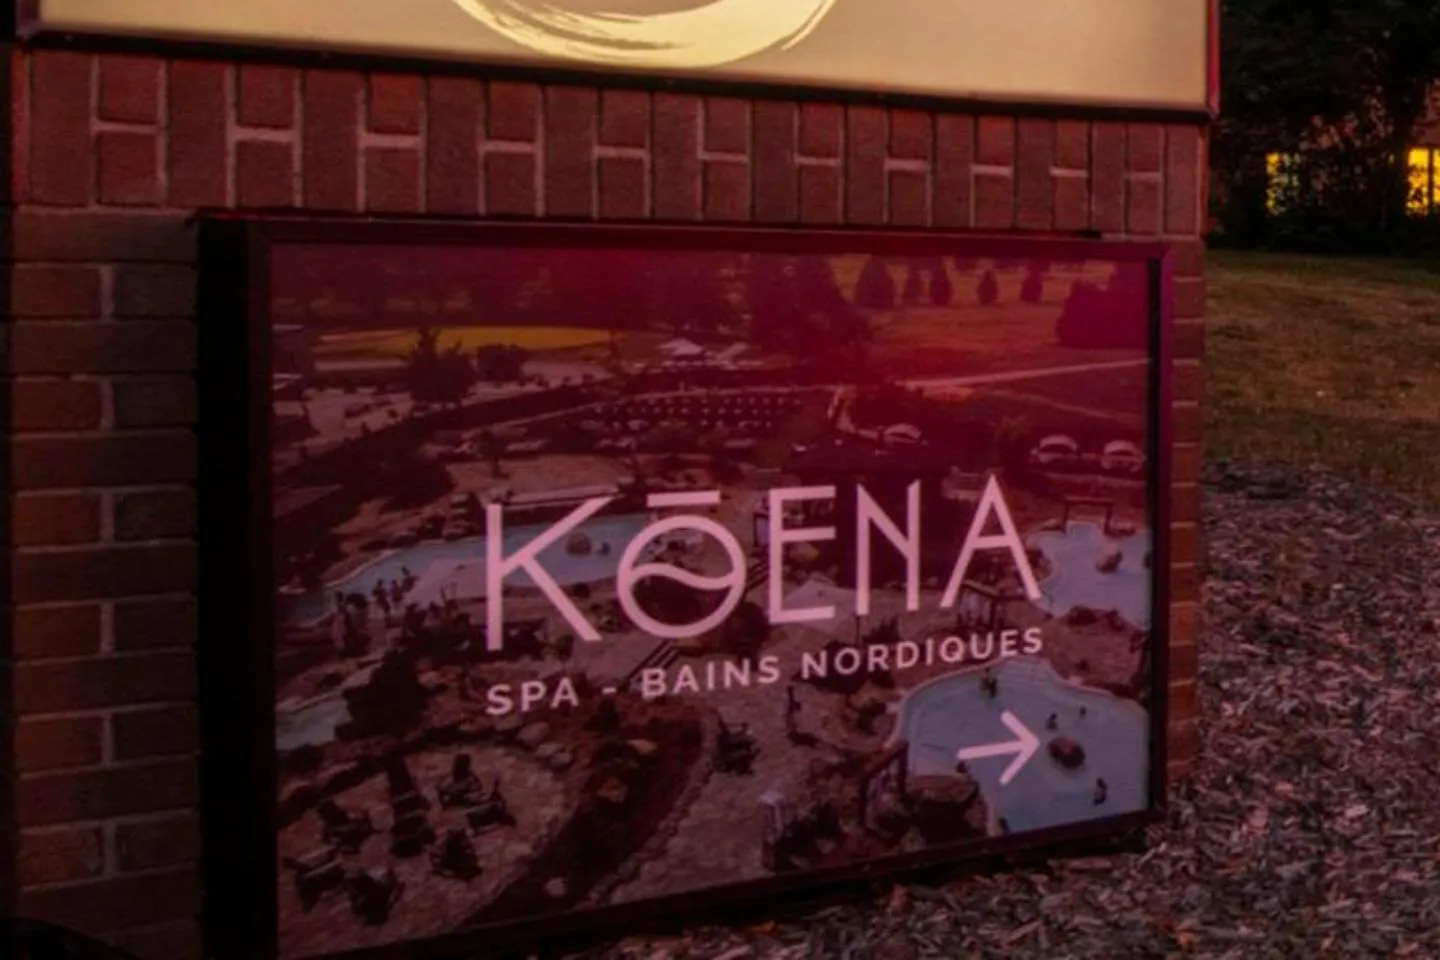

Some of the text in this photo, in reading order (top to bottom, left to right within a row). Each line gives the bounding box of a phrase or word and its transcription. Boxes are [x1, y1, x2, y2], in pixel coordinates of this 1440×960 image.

[484, 682, 580, 718] SPA
[640, 654, 781, 700] BAINS
[799, 625, 1045, 681] NORDIQUES
